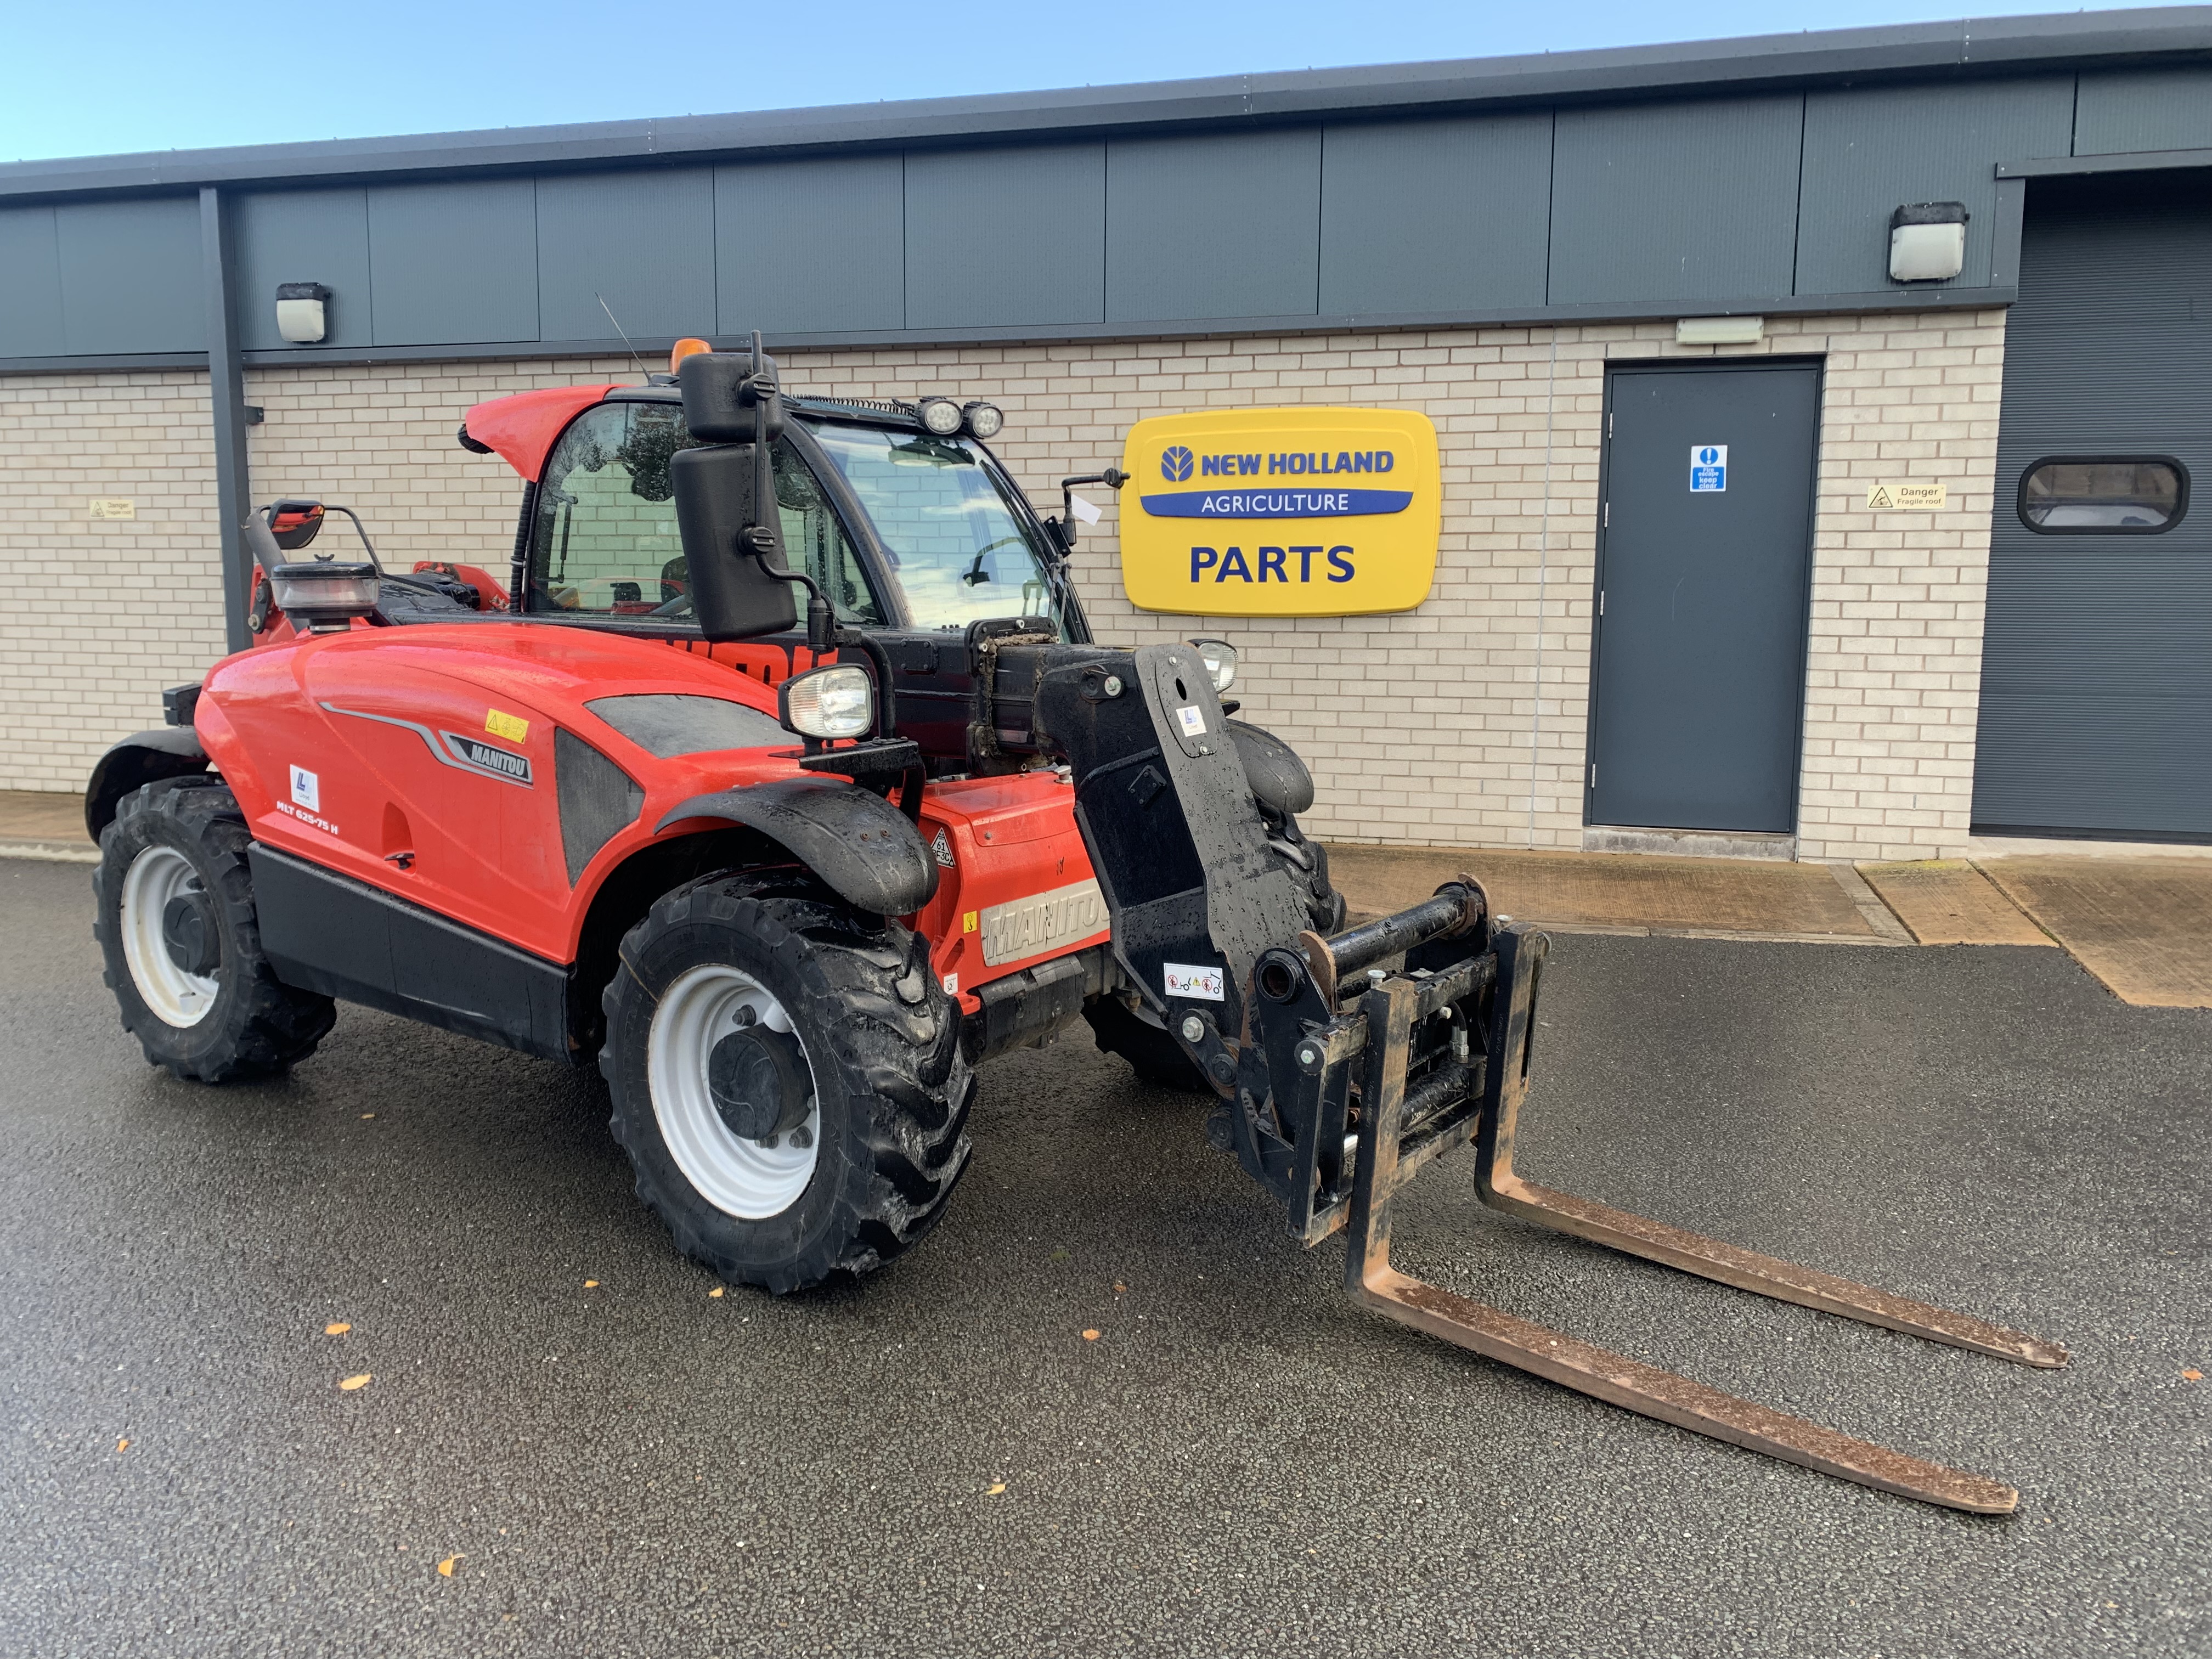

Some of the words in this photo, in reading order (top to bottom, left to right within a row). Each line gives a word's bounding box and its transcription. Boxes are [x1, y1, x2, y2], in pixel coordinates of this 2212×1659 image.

[1202, 454, 1262, 476] NEW
[1268, 451, 1394, 474] HOLLAND
[1201, 494, 1349, 512] AGRICULTURE
[1901, 488, 1938, 497] Danger
[1191, 545, 1355, 583] PARTS
[471, 744, 526, 776] MANITOU
[276, 800, 295, 816] MLT
[296, 809, 329, 831] 625-75
[330, 824, 338, 835] H
[937, 842, 945, 851] 61
